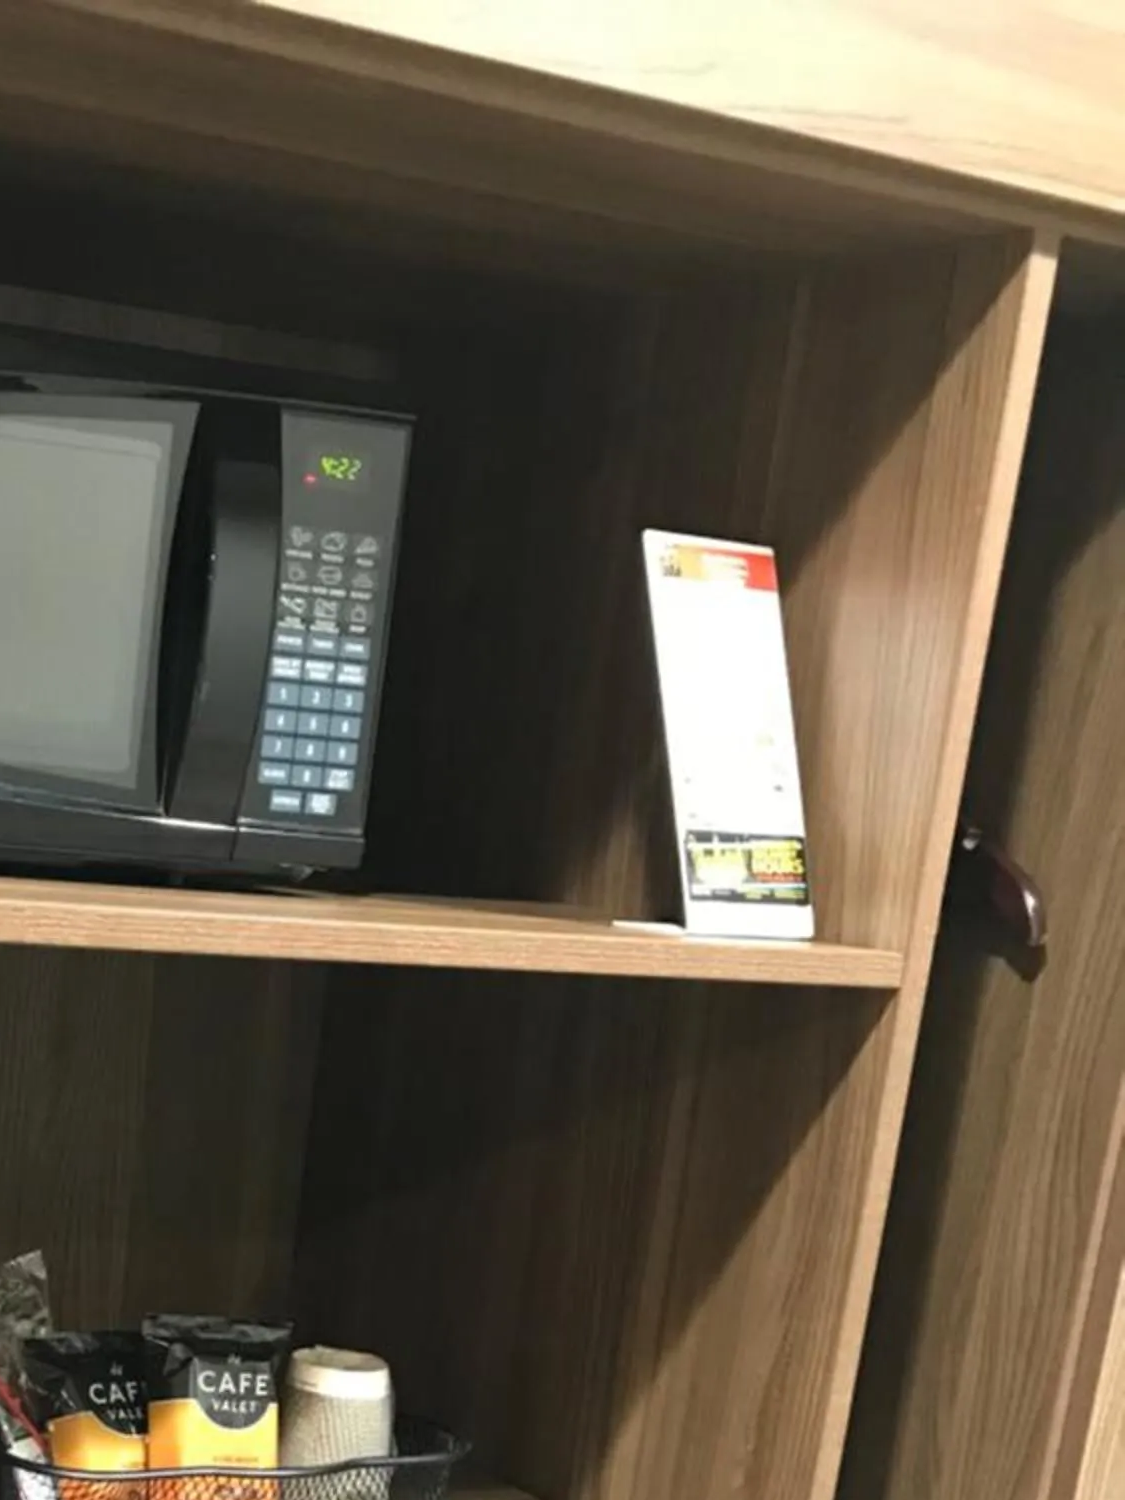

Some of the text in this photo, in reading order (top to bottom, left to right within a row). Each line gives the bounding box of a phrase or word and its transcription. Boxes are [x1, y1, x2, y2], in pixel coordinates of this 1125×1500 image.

[89, 1381, 147, 1405] CAF
[197, 1370, 269, 1397] CAFE
[212, 1399, 256, 1414] VALET
